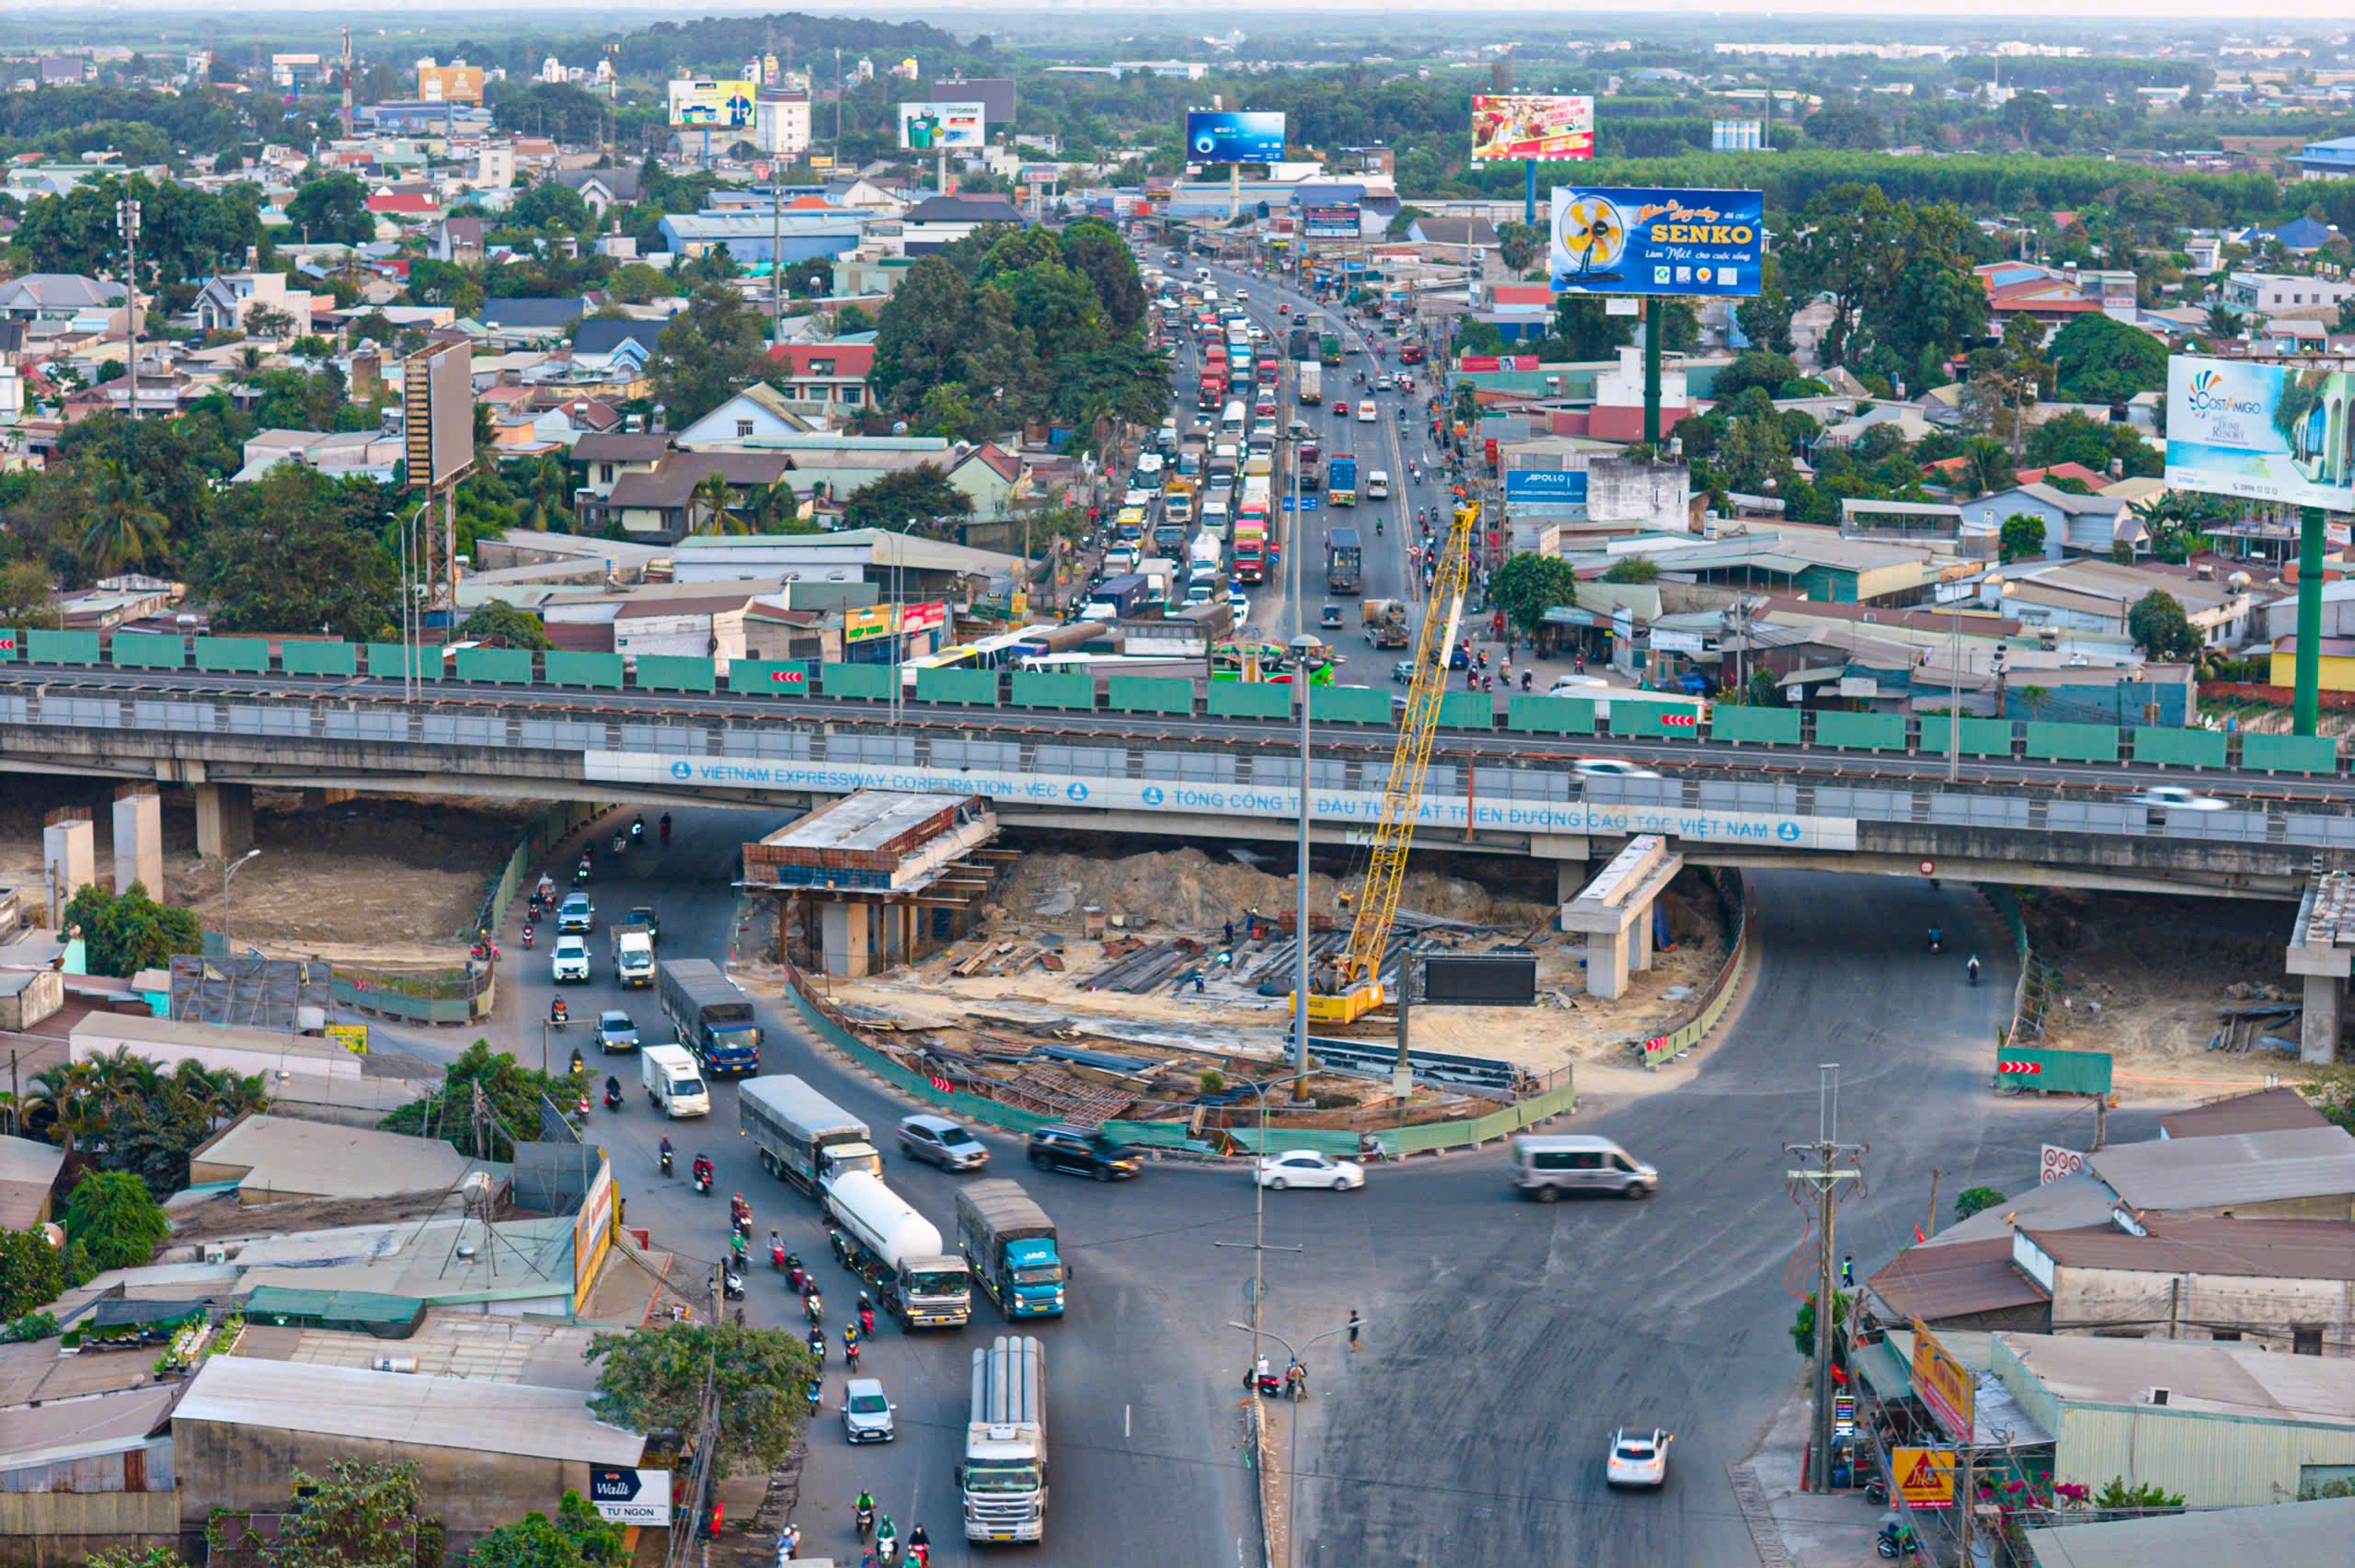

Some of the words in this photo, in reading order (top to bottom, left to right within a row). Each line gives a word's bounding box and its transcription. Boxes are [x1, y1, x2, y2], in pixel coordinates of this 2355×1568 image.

[1651, 224, 1753, 244] SENKO
[1524, 474, 1565, 483] APOLLO
[699, 765, 769, 782] VIETNAM
[774, 769, 886, 787] EXPRESSWAY
[893, 774, 1013, 795] CORPORATION
[1024, 782, 1059, 799] VEC
[1588, 812, 1627, 830] CAO
[1679, 815, 1721, 839] VIỆT
[1727, 820, 1769, 839] NAM
